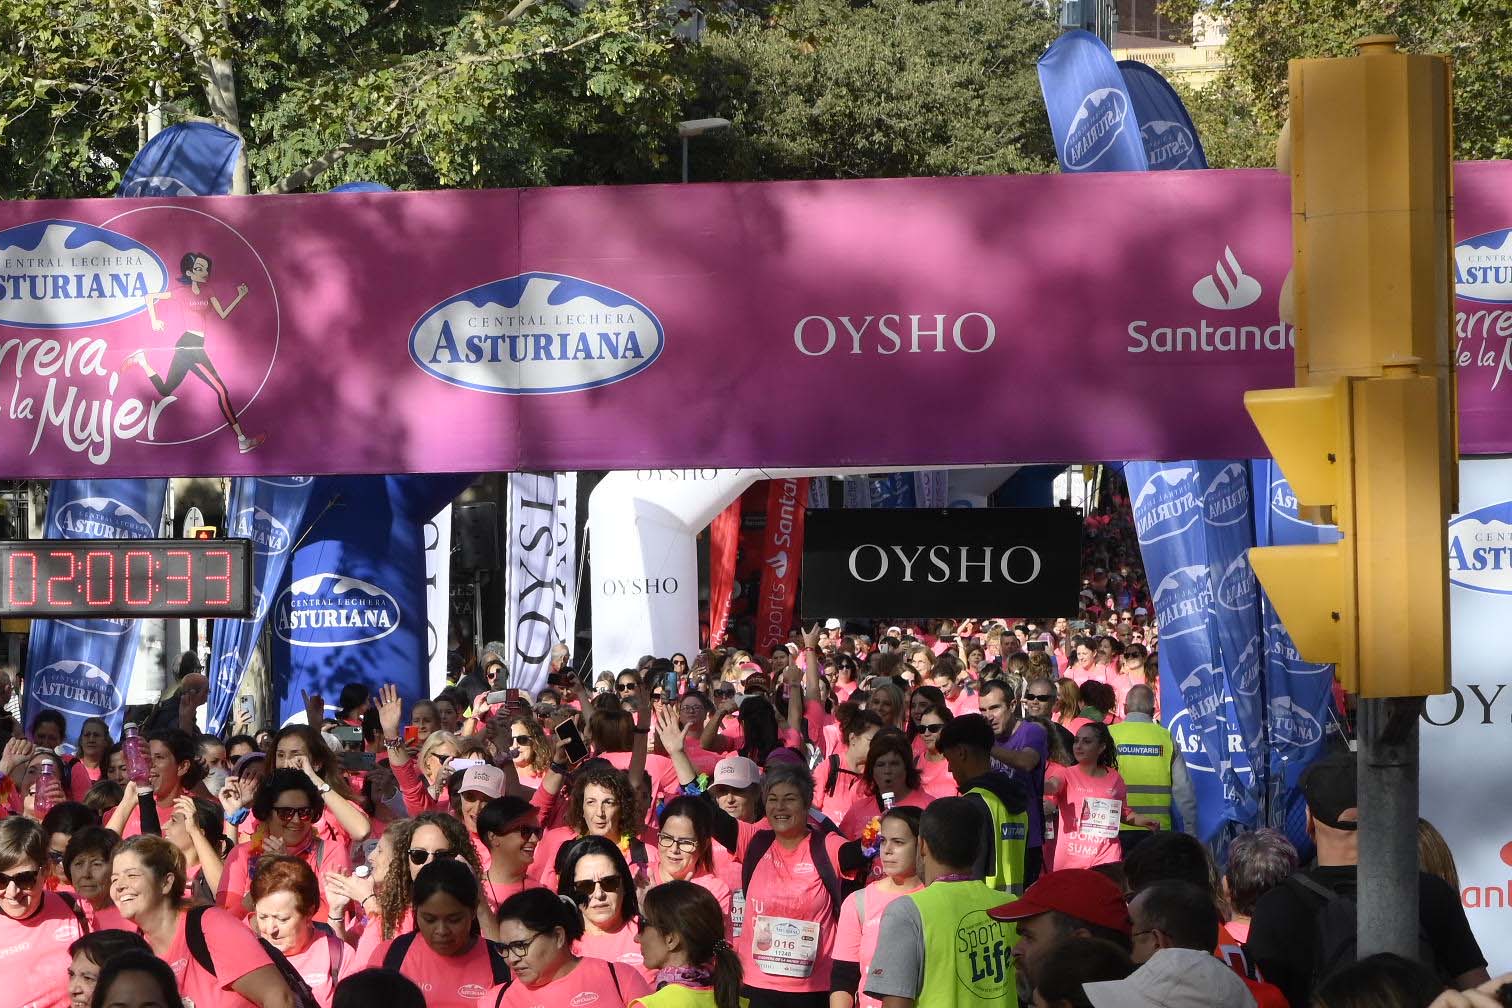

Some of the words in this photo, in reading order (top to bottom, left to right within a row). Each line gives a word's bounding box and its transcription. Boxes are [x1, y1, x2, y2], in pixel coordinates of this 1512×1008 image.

[71, 255, 143, 268] LECHERA
[468, 314, 546, 328] CENTRAL
[555, 313, 635, 326] LECHERA
[428, 319, 645, 364] ASTURIANA
[793, 312, 996, 356] OYSHO
[9, 379, 34, 420] la
[29, 371, 178, 465] Mujer
[848, 544, 1042, 586] OYSHO
[9, 551, 231, 606] 02:00:33
[603, 576, 678, 596] OYSHO
[291, 598, 333, 608] CENTRAL
[338, 597, 386, 607] LECHERA
[278, 604, 391, 630] ASTURIANA
[1067, 843, 1099, 856] SUMA
[774, 939, 795, 950] 016
[957, 921, 1006, 953] Sport
